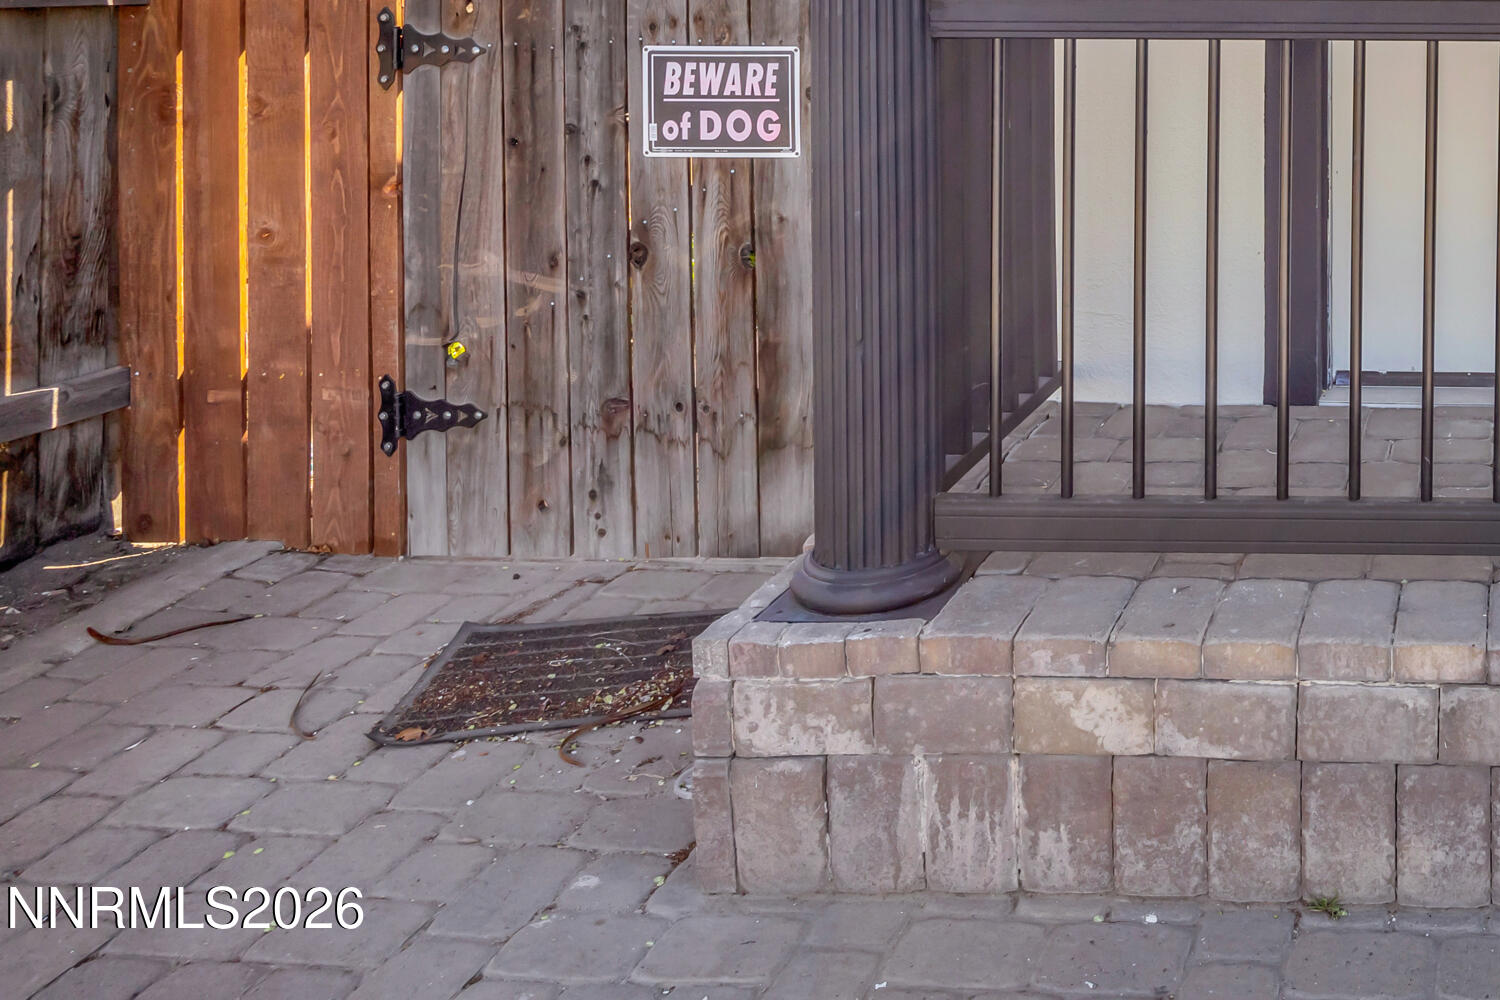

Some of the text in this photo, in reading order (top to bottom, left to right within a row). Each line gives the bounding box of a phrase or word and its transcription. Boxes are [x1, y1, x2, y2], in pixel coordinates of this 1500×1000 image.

[663, 61, 780, 97] BEWARE
[662, 111, 692, 141] of
[699, 109, 782, 142] DOG
